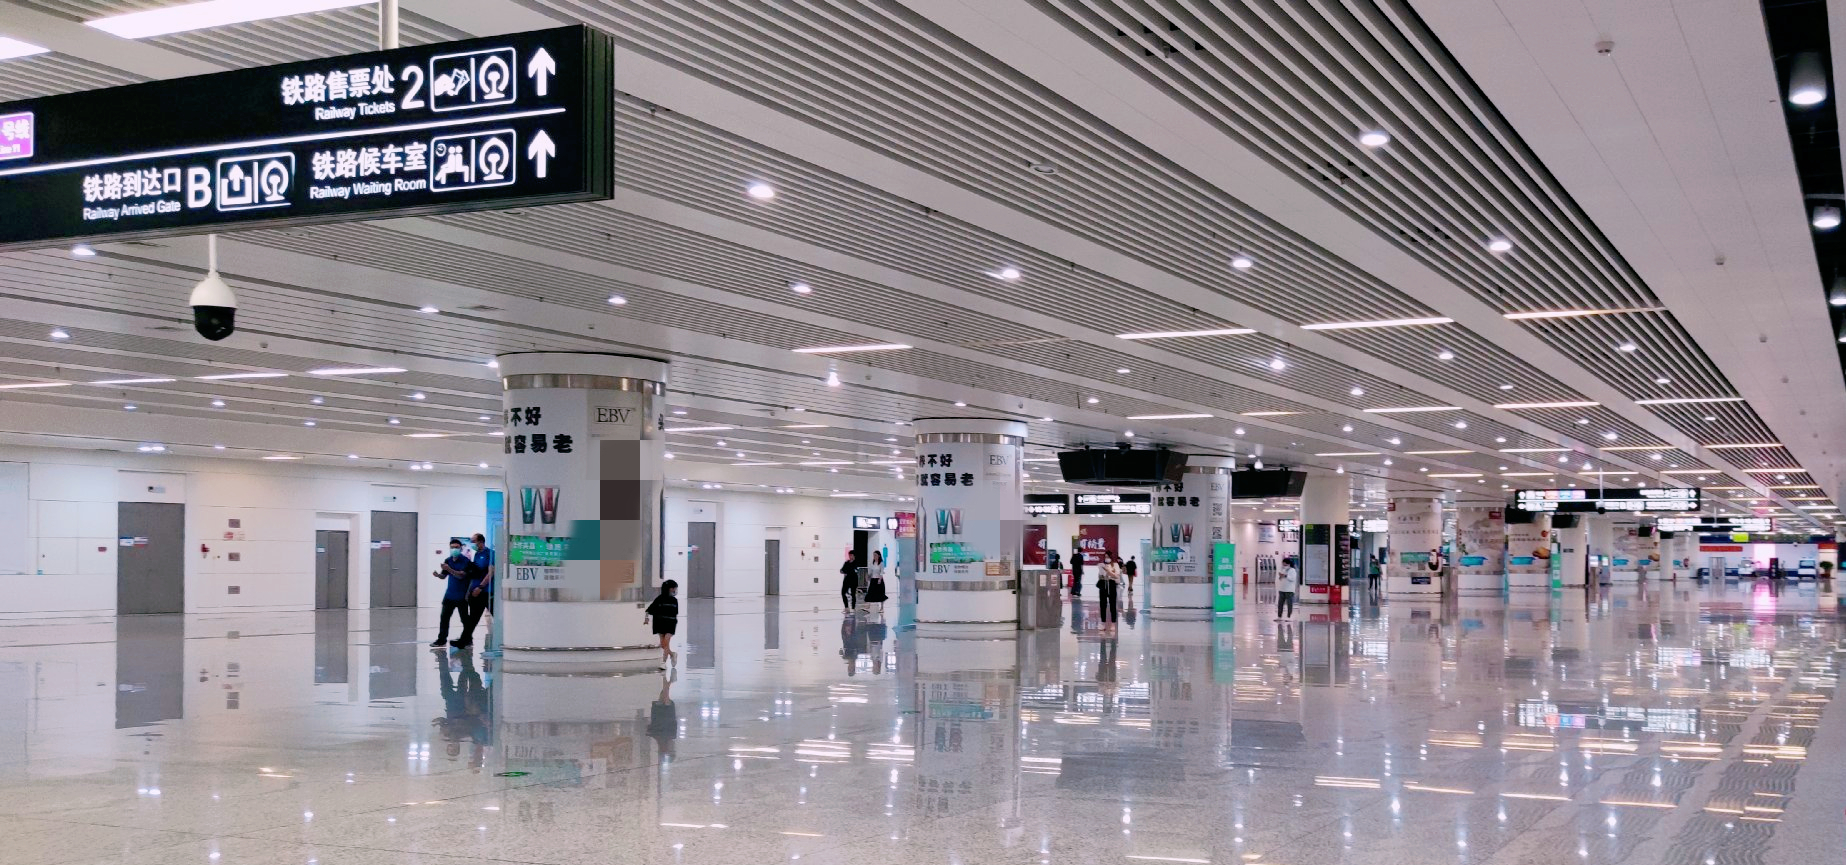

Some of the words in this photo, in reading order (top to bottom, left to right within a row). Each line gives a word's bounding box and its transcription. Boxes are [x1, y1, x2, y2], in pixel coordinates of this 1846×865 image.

[281, 65, 395, 105] 铁路售票处
[401, 65, 424, 109] 2
[315, 107, 356, 120] Railway
[358, 101, 395, 115] Tickets
[312, 142, 427, 180] 铁路候车室
[83, 168, 181, 202] 铁路到达口
[188, 167, 212, 208] B
[310, 186, 350, 199] Railway
[353, 181, 392, 195] Waiting
[394, 179, 426, 191] Room
[83, 206, 120, 220] Railway
[121, 202, 155, 216] Arrived
[157, 199, 181, 212] Gate
[597, 408, 631, 422] EBV
[990, 455, 1010, 465] EBV
[916, 473, 974, 487] 就容易老
[516, 567, 538, 580] EBV
[932, 564, 950, 574] EBV
